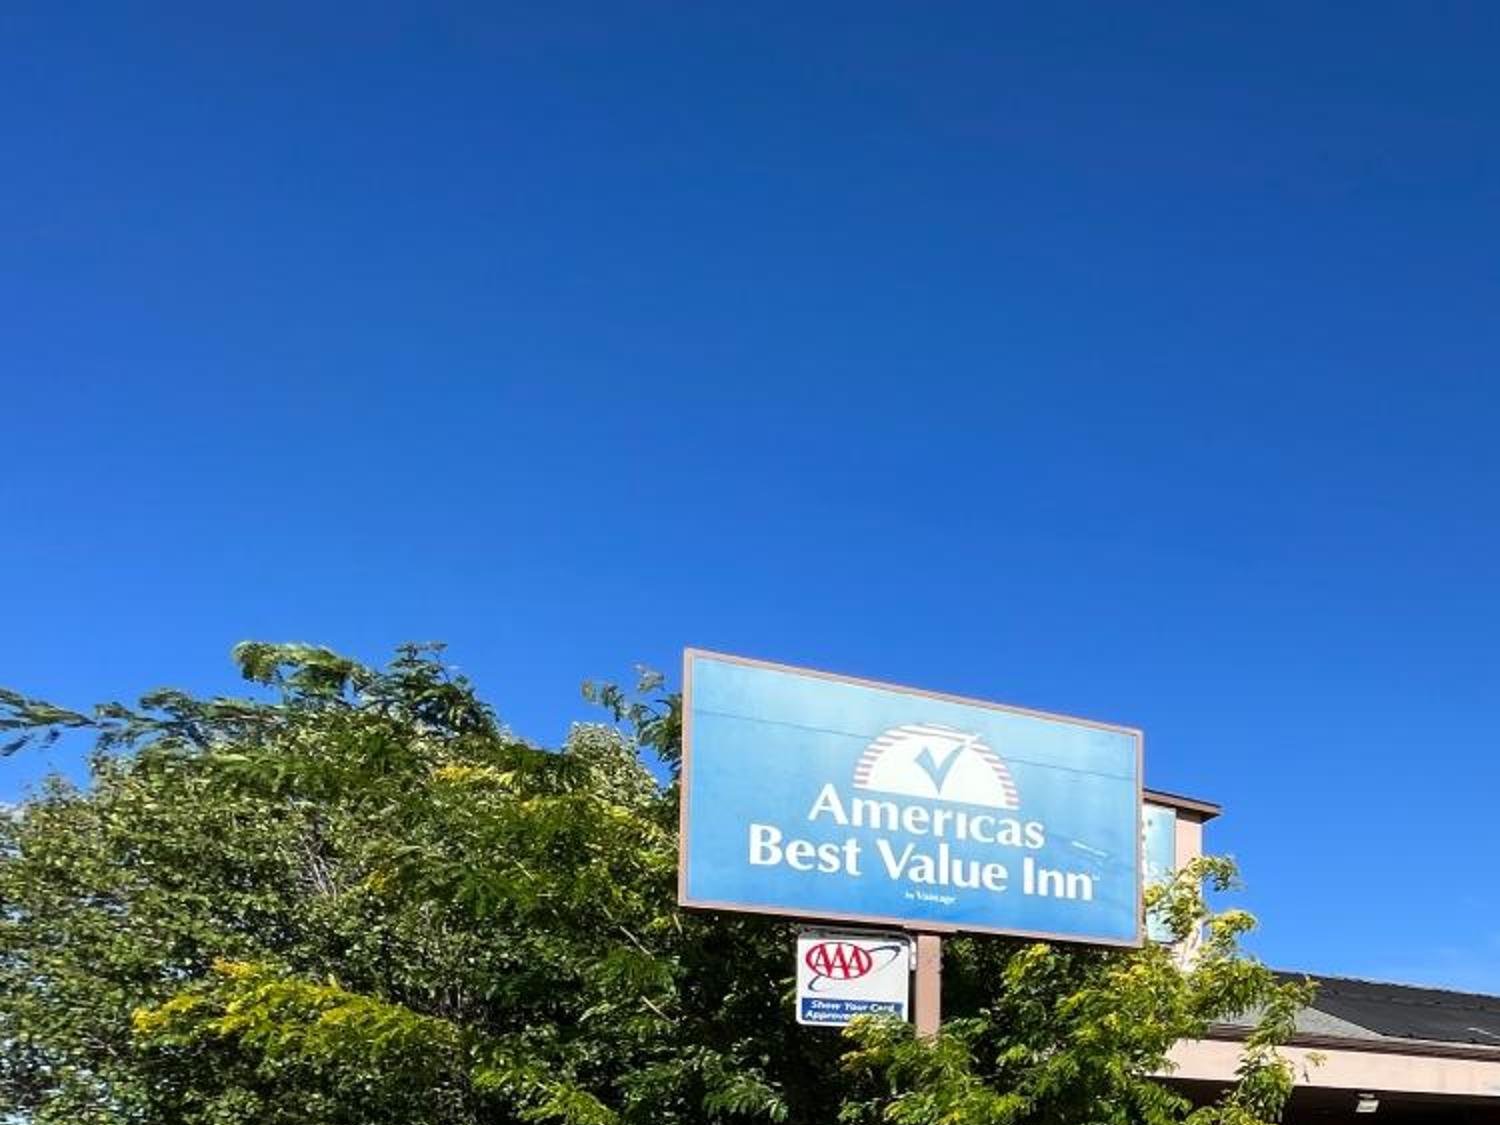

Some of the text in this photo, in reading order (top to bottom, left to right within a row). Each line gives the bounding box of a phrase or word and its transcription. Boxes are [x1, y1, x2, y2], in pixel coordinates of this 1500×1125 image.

[808, 783, 1046, 849] Americas
[749, 823, 1094, 900] Best Value Inn
[809, 943, 868, 979] AAA
[811, 1000, 895, 1014] Show Your Card
